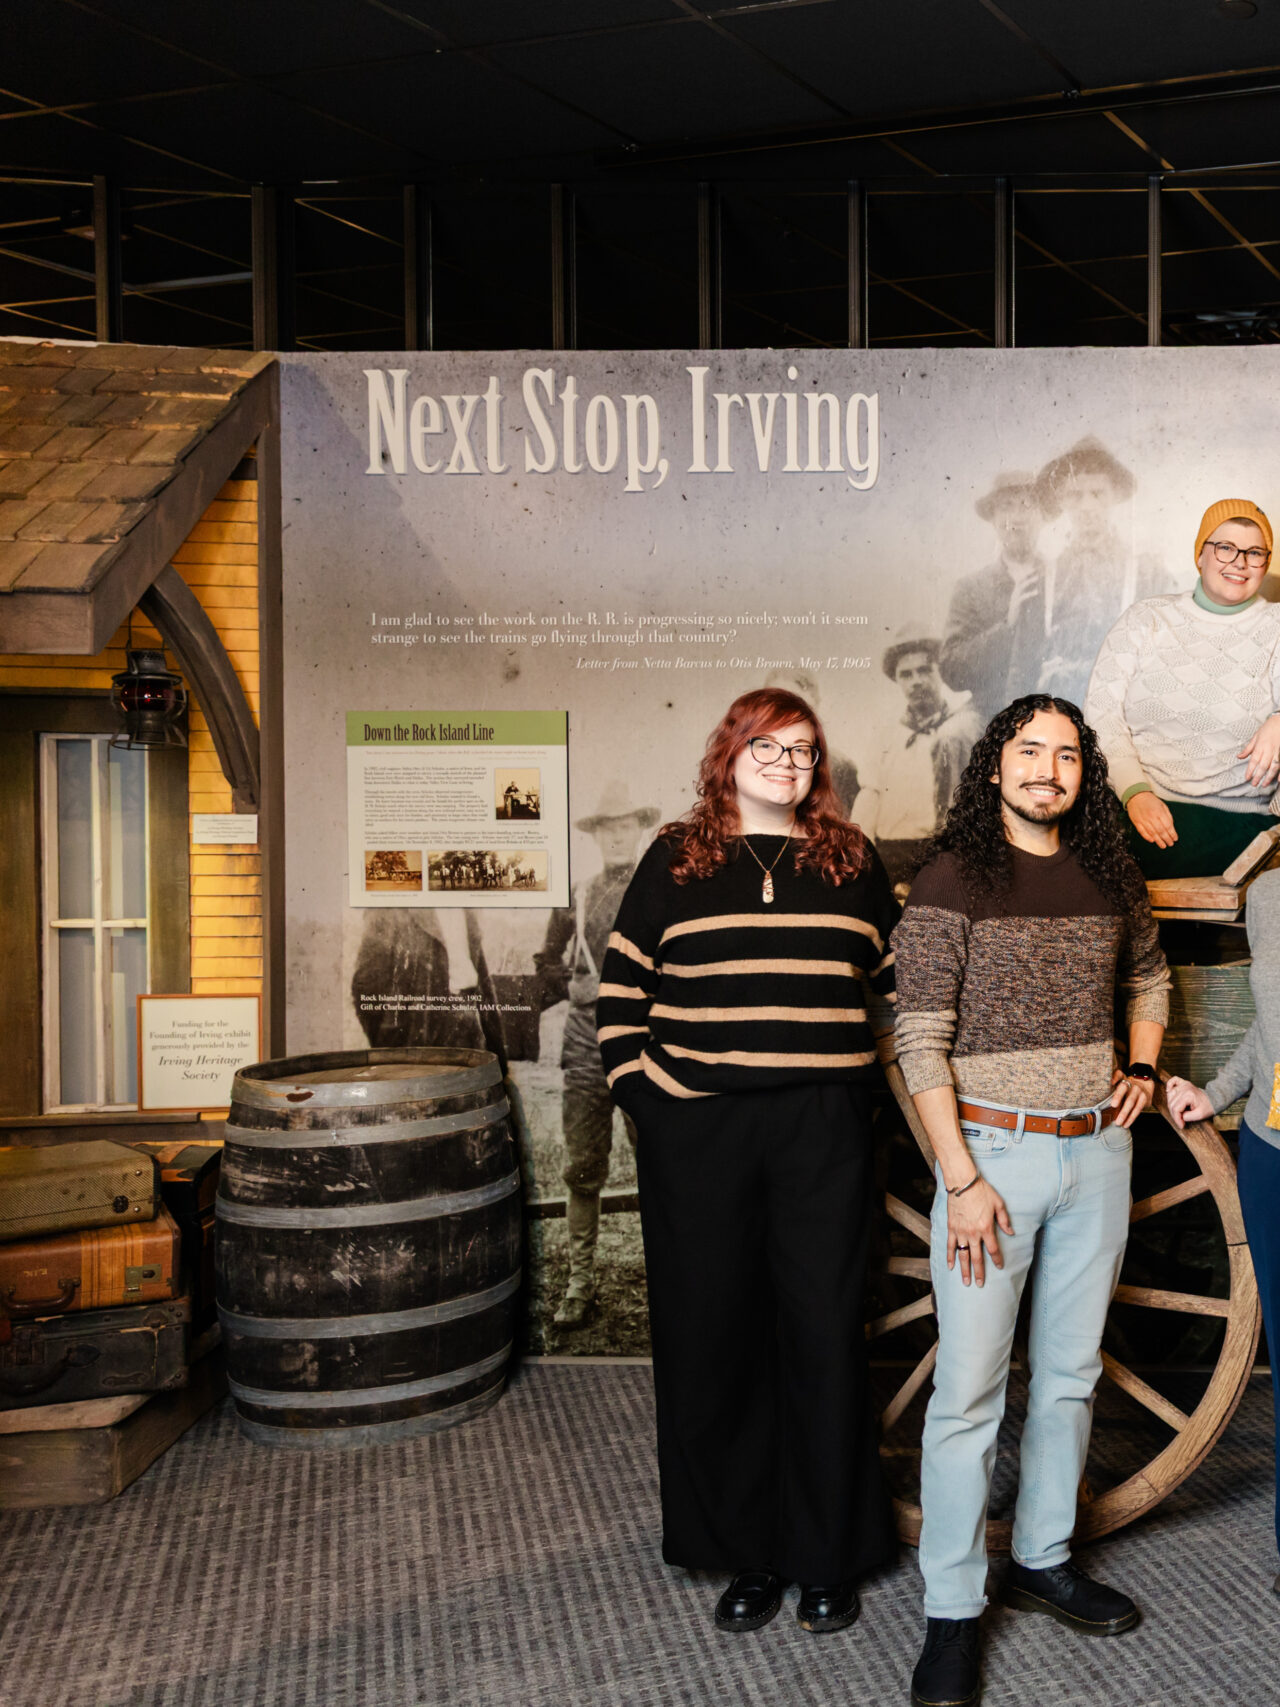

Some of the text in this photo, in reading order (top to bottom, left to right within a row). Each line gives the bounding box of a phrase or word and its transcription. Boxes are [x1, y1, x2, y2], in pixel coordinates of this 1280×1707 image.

[363, 366, 880, 492] Next Stop, Irving
[371, 612, 376, 625] I
[381, 616, 400, 625] am
[404, 612, 432, 629] glad
[436, 614, 450, 625] to
[453, 616, 474, 625] see
[478, 612, 500, 625] the
[504, 612, 536, 625] work
[541, 616, 557, 625] on
[562, 612, 583, 625] the
[588, 612, 601, 625] R.
[606, 612, 619, 625] R.
[624, 611, 634, 625] is
[638, 612, 714, 629] progressing
[718, 615, 733, 625] so
[783, 611, 817, 625] won't
[821, 611, 831, 625] it
[834, 615, 869, 625] seem
[371, 629, 737, 647] strange to see the trains go flying through that country?
[576, 657, 610, 669] Letter
[611, 657, 639, 672] from
[716, 659, 727, 669] to
[730, 657, 752, 669] Otis
[798, 657, 823, 672] May
[364, 723, 495, 741] Down the Rock Island Line
[360, 994, 377, 1002] Rock
[378, 994, 397, 1002] Island
[399, 994, 425, 1002] Railroad
[426, 995, 447, 1003] survey
[360, 1003, 374, 1011] Gift
[374, 1003, 382, 1011] of
[383, 1003, 407, 1011] Charles
[172, 1019, 228, 1029] Funding for the
[149, 1031, 187, 1040] Founding
[188, 1030, 198, 1039] of
[199, 1030, 223, 1040] Irving
[192, 1041, 225, 1051] provided
[226, 1041, 235, 1050] by
[237, 1041, 249, 1049] the
[158, 1054, 243, 1068] Irving Heritage
[181, 1069, 221, 1082] Society
